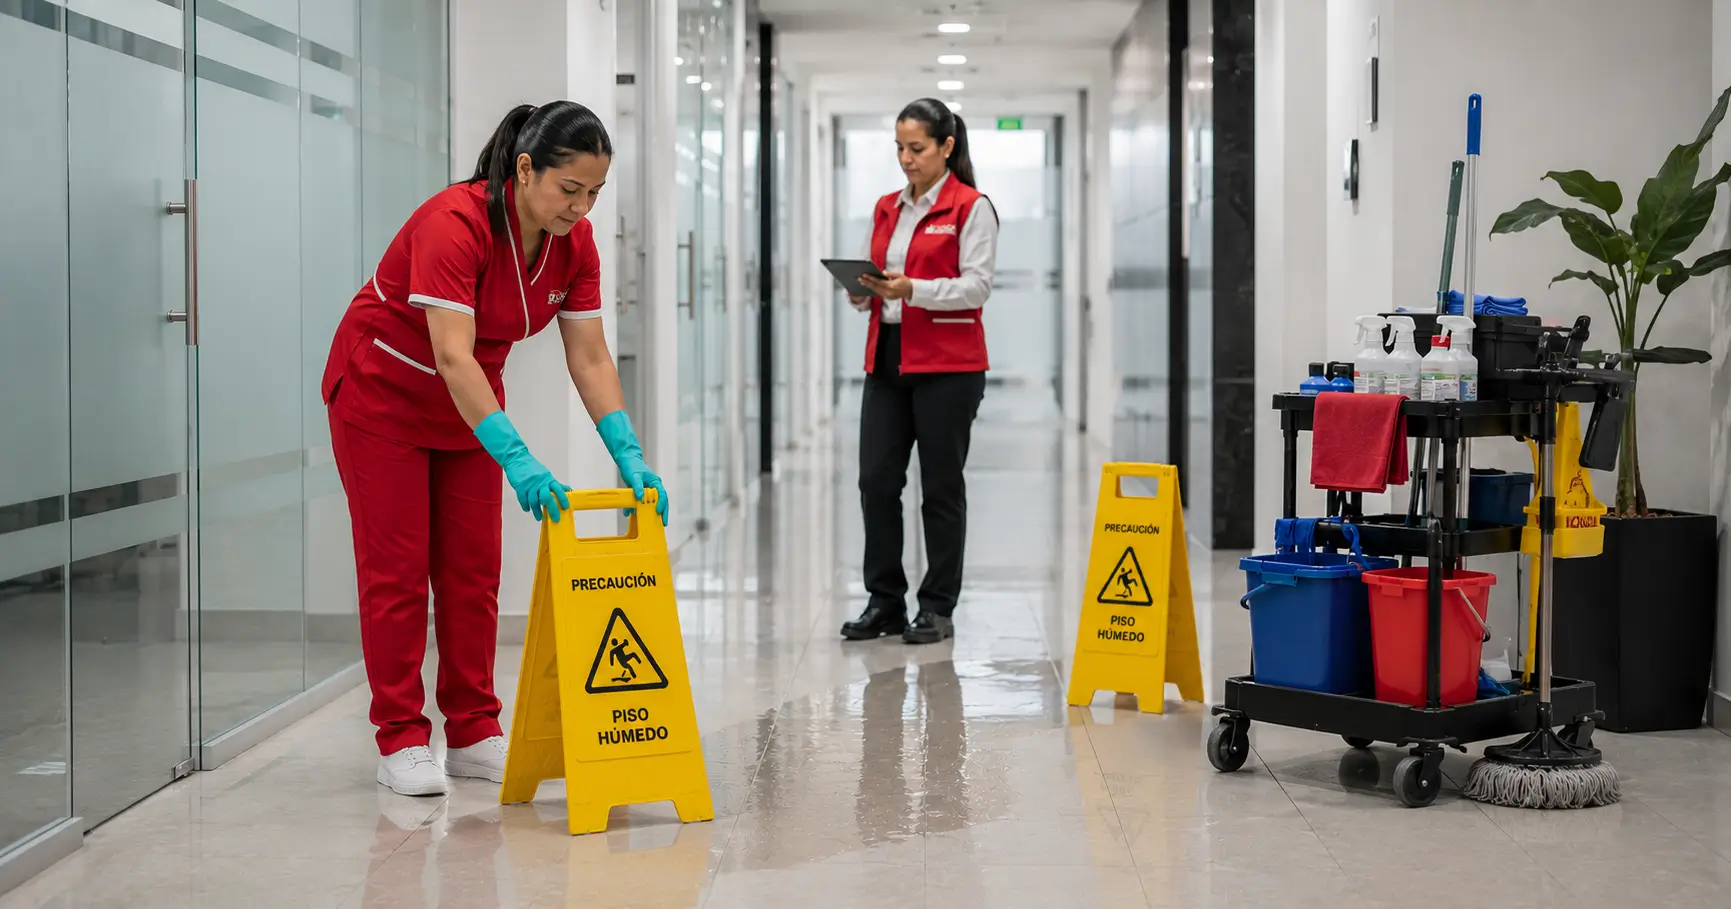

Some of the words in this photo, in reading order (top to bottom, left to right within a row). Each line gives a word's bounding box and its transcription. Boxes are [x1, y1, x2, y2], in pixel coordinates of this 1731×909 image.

[1104, 523, 1160, 535] PRECAUCIÓN
[571, 572, 657, 591] PRECAUCIÓN
[1110, 615, 1136, 627] PISO
[1097, 628, 1145, 642] HÚMEDO
[612, 707, 649, 723] PISO
[597, 726, 669, 745] HÚMEDO
